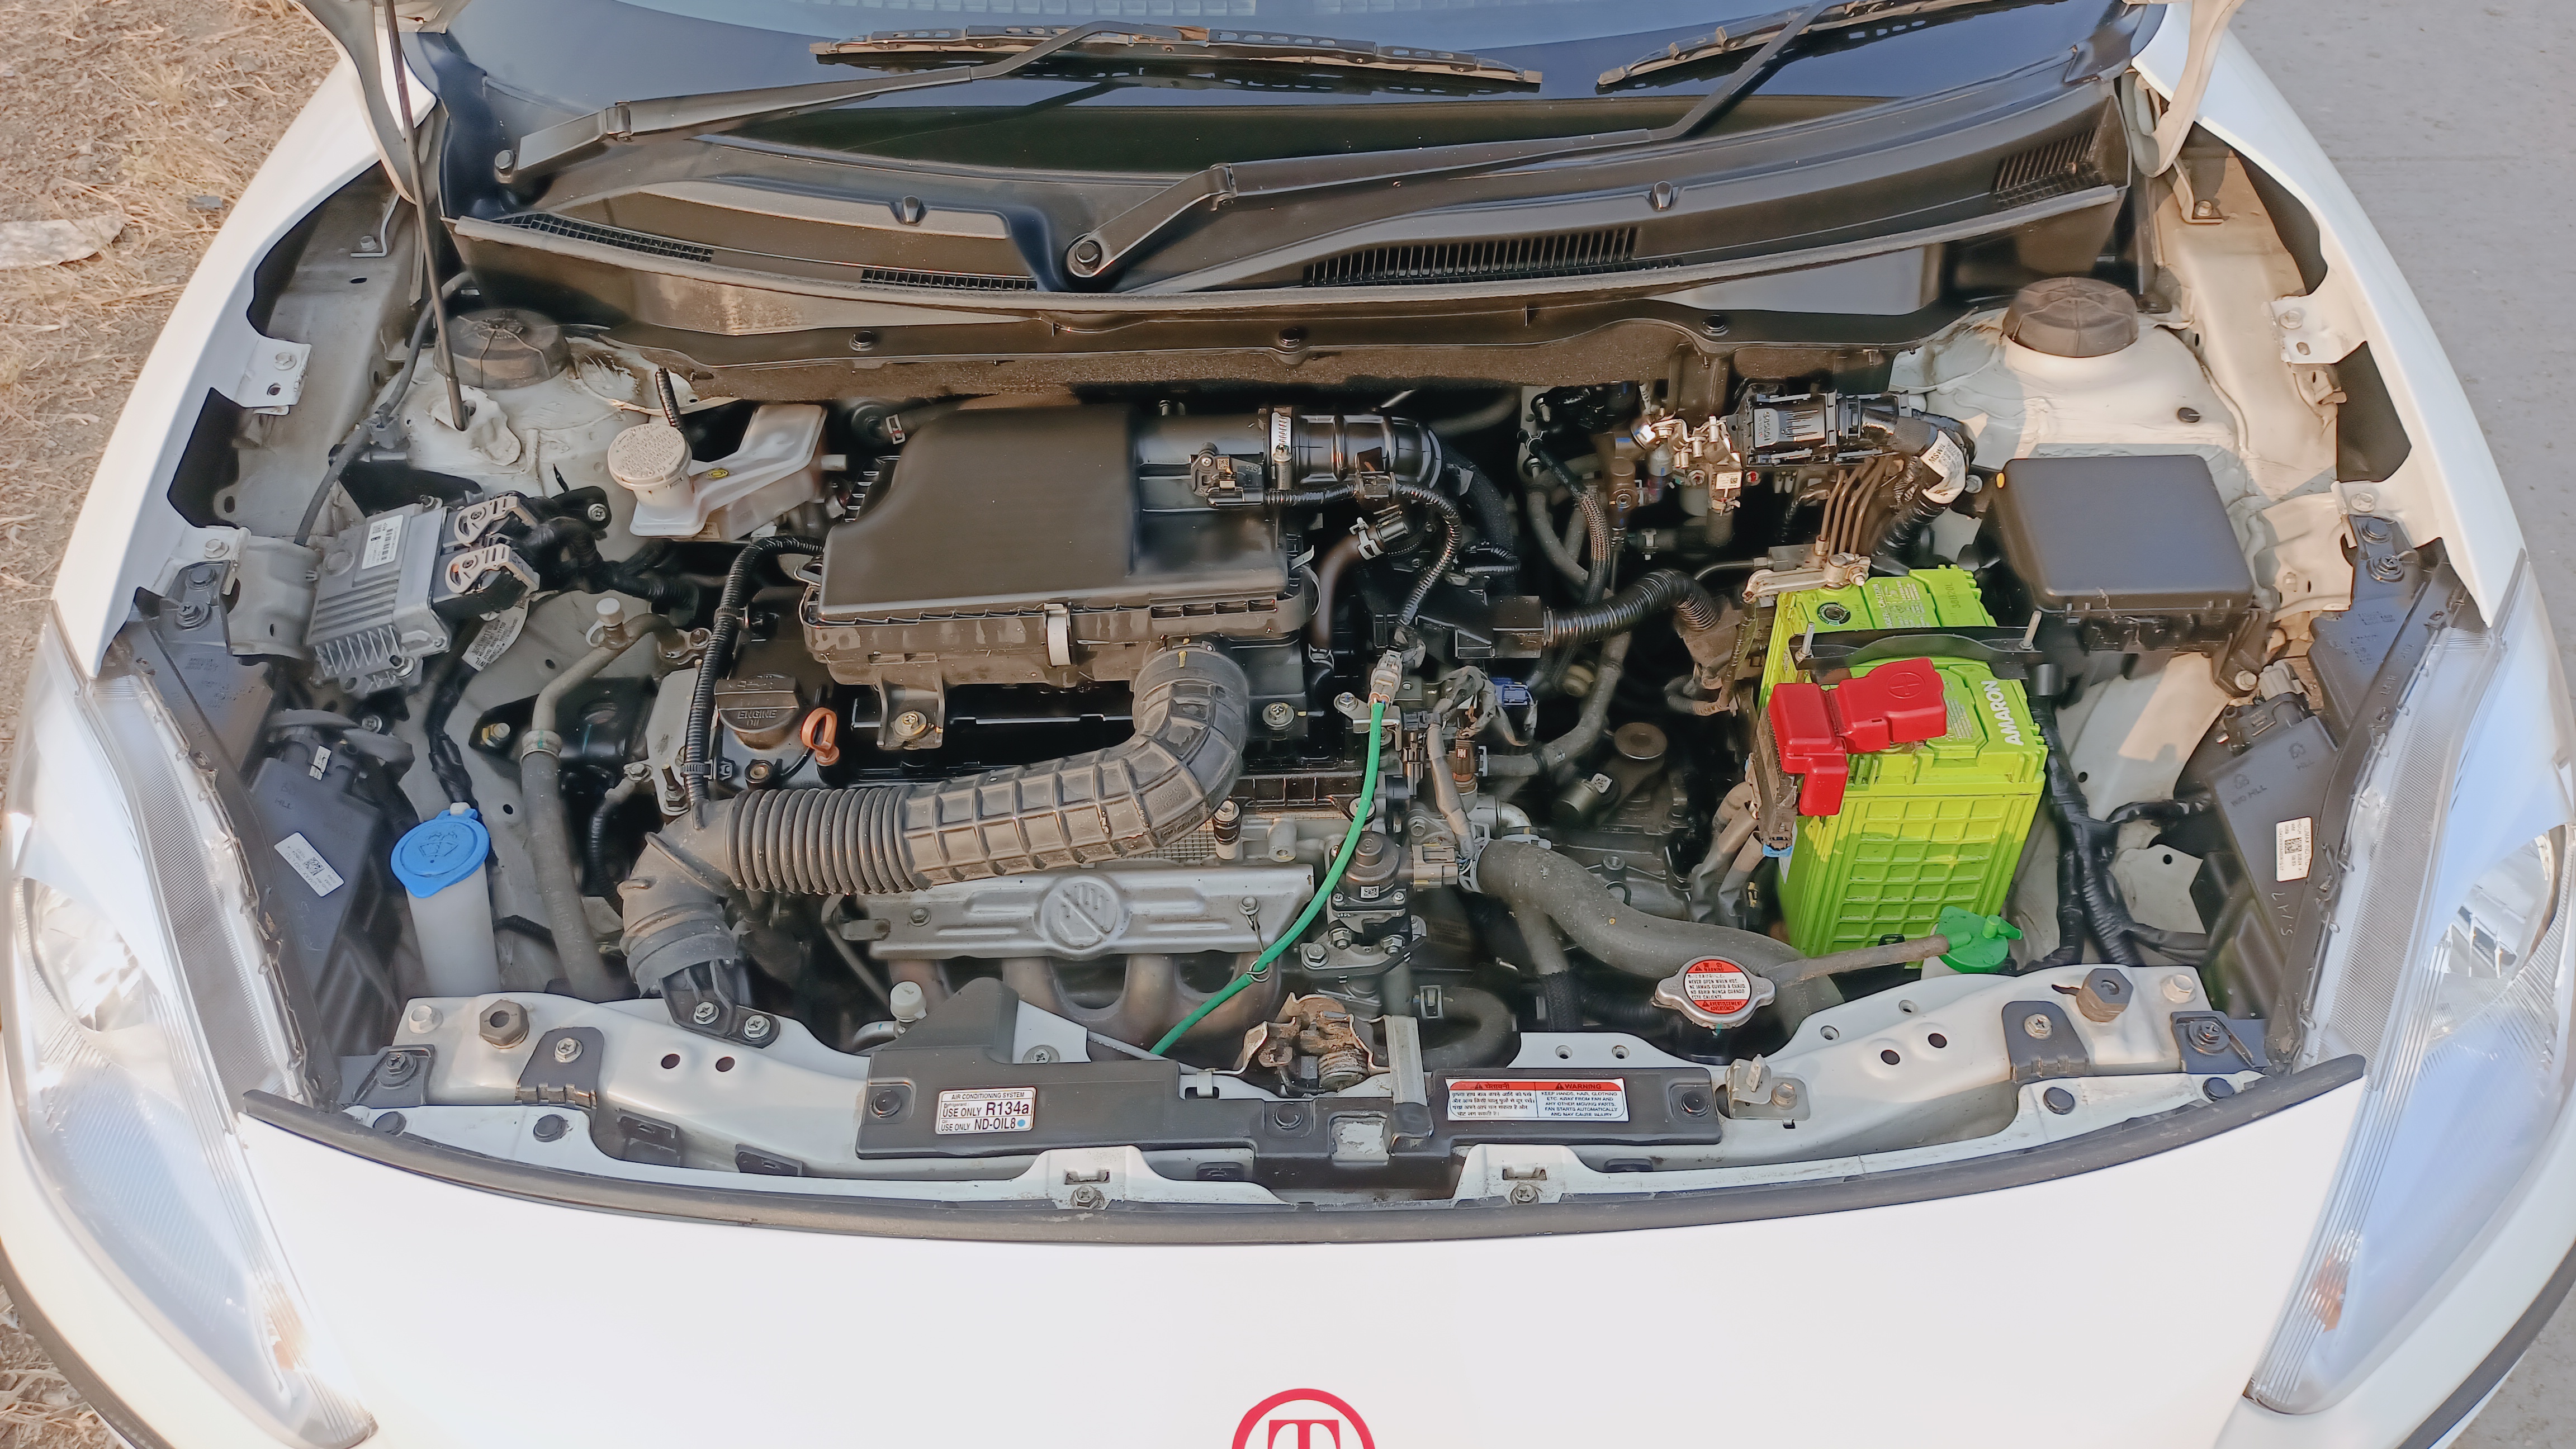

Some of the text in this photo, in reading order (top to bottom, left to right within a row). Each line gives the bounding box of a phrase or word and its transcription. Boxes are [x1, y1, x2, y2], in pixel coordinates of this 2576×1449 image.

[1929, 443, 1945, 464] MSWIL
[737, 710, 778, 719] ENGINE
[1982, 680, 2024, 746] AMARON
[943, 1101, 1029, 1117] USE ONLY R134a
[974, 1118, 1016, 1130] ND-OIL8
